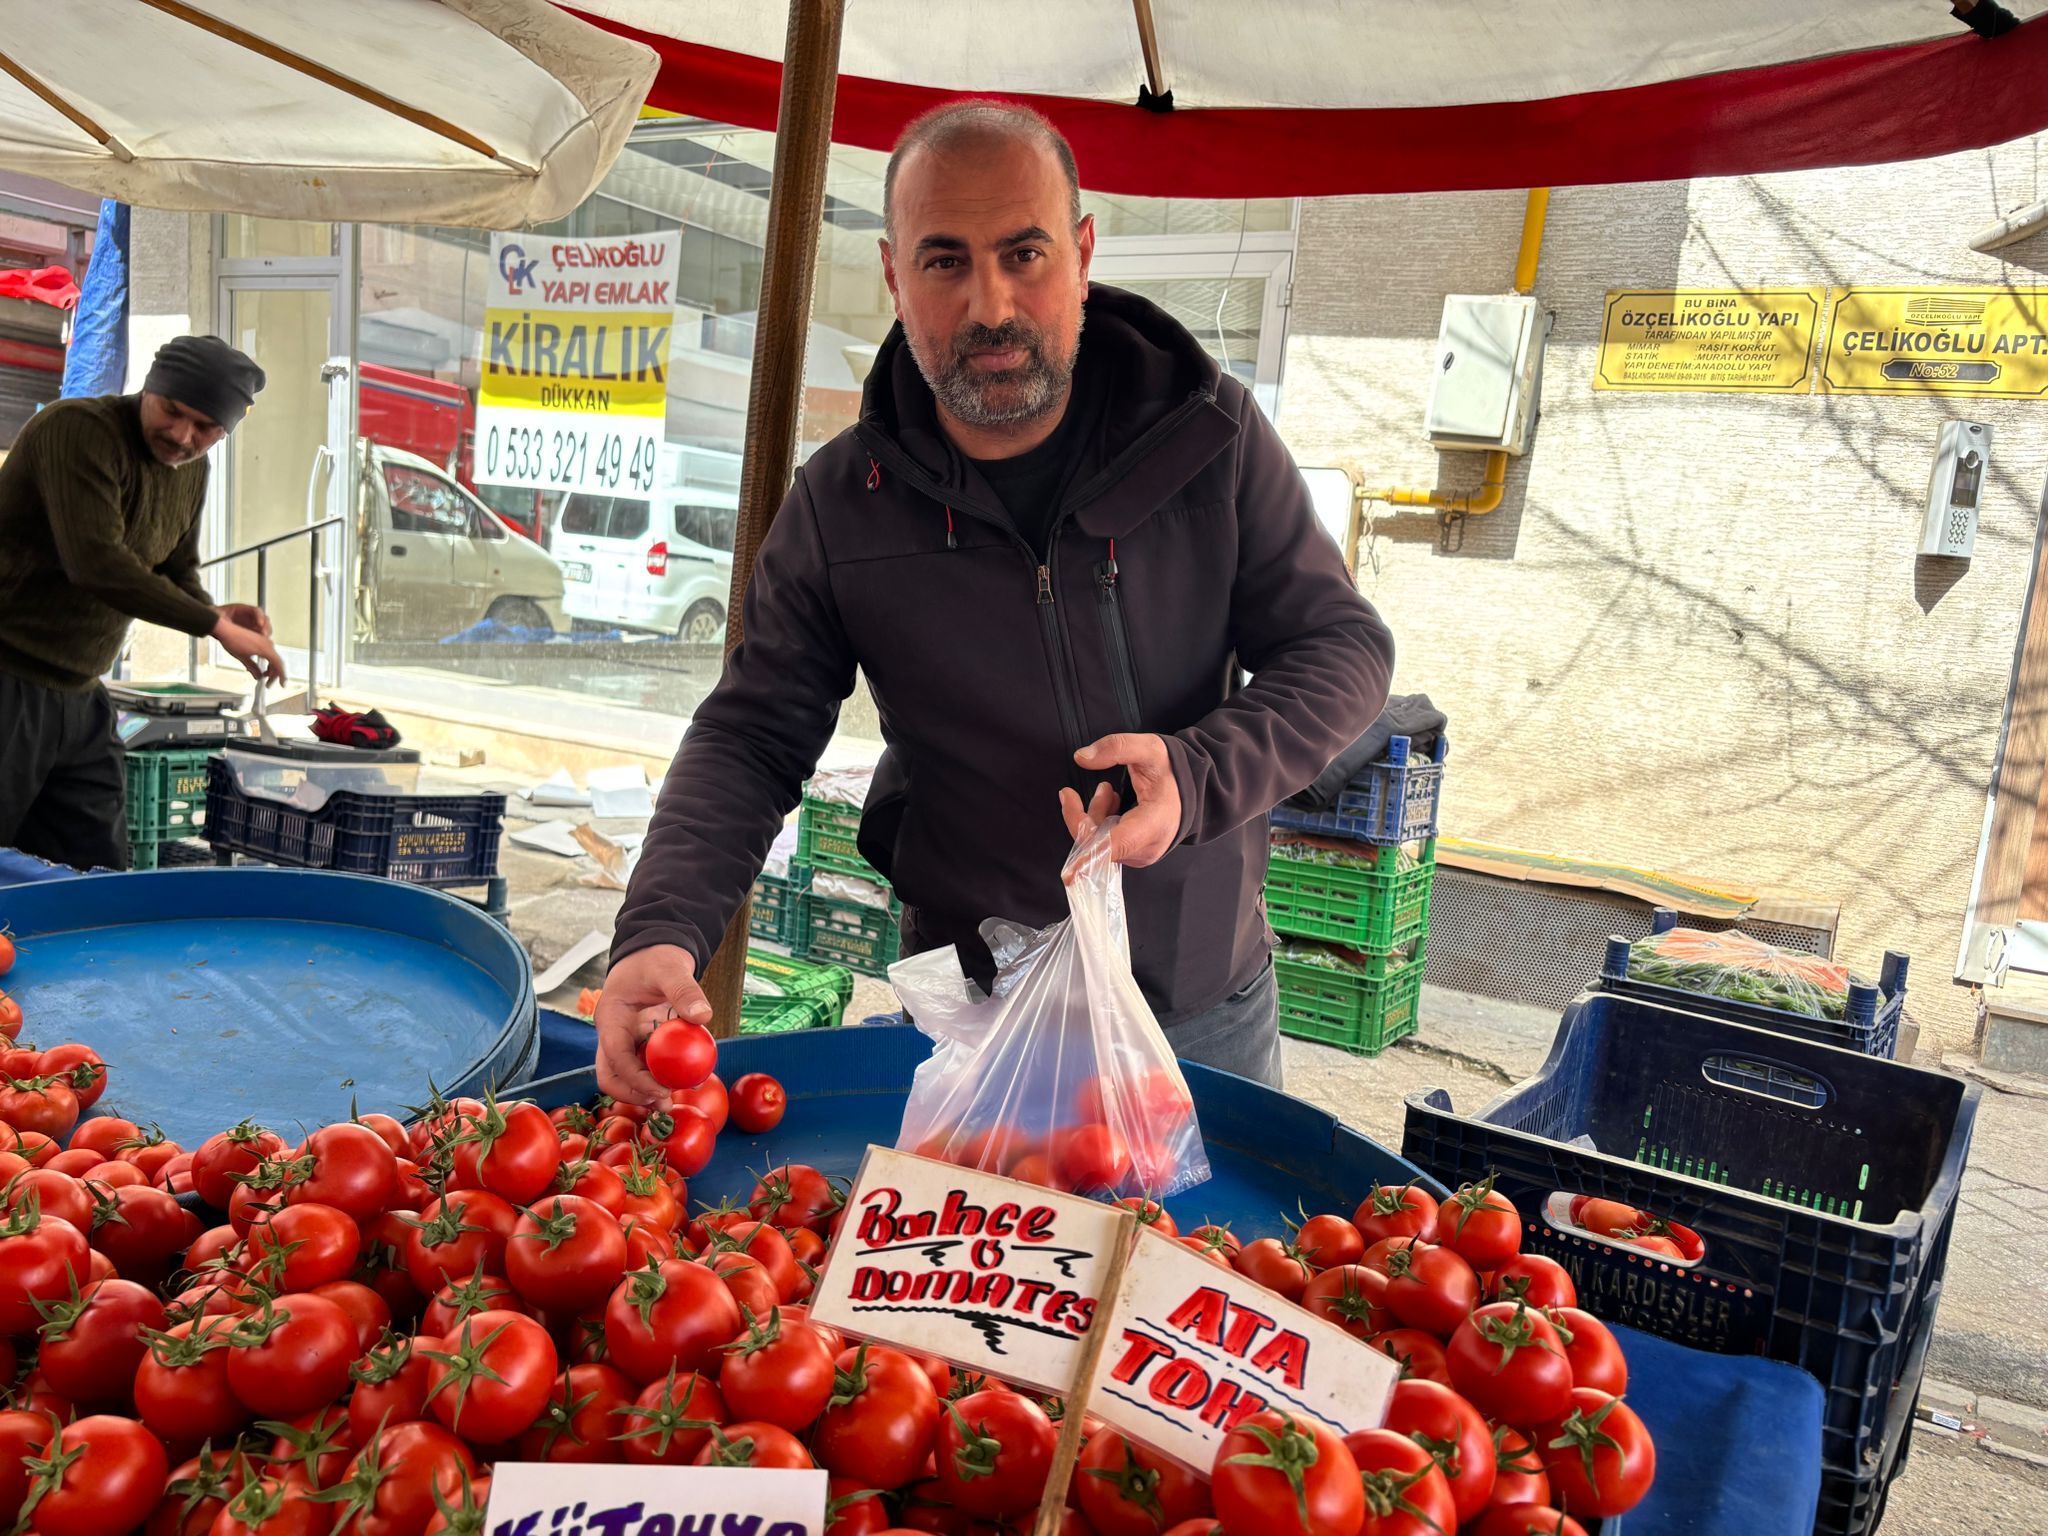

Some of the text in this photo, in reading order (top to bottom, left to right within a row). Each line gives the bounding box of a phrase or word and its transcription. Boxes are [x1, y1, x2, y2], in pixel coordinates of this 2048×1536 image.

[541, 281, 669, 305] YAPI EMLAK
[1684, 299, 1702, 308] BU
[1621, 309, 1799, 330] ÖZÇELİKOĞLU YAPI
[1644, 330, 1773, 341] TARAFINDAN YAPILMIŞTIR
[1843, 327, 2048, 357] ÇELİKOĞLU APT.
[488, 312, 669, 383] KİRALIK
[1624, 352, 1659, 361] STATİK
[1735, 353, 1781, 362] KORKUT
[1731, 344, 1777, 352] KORKUT
[1624, 361, 1645, 370] YAPI
[1748, 363, 1772, 372] YAPI
[1909, 363, 1960, 379] No:52
[541, 384, 610, 411] DÜKKAN
[487, 425, 655, 491] 0 533 321 49 49
[1166, 1286, 1310, 1390] ATA
[1110, 1328, 1268, 1434] TOH
